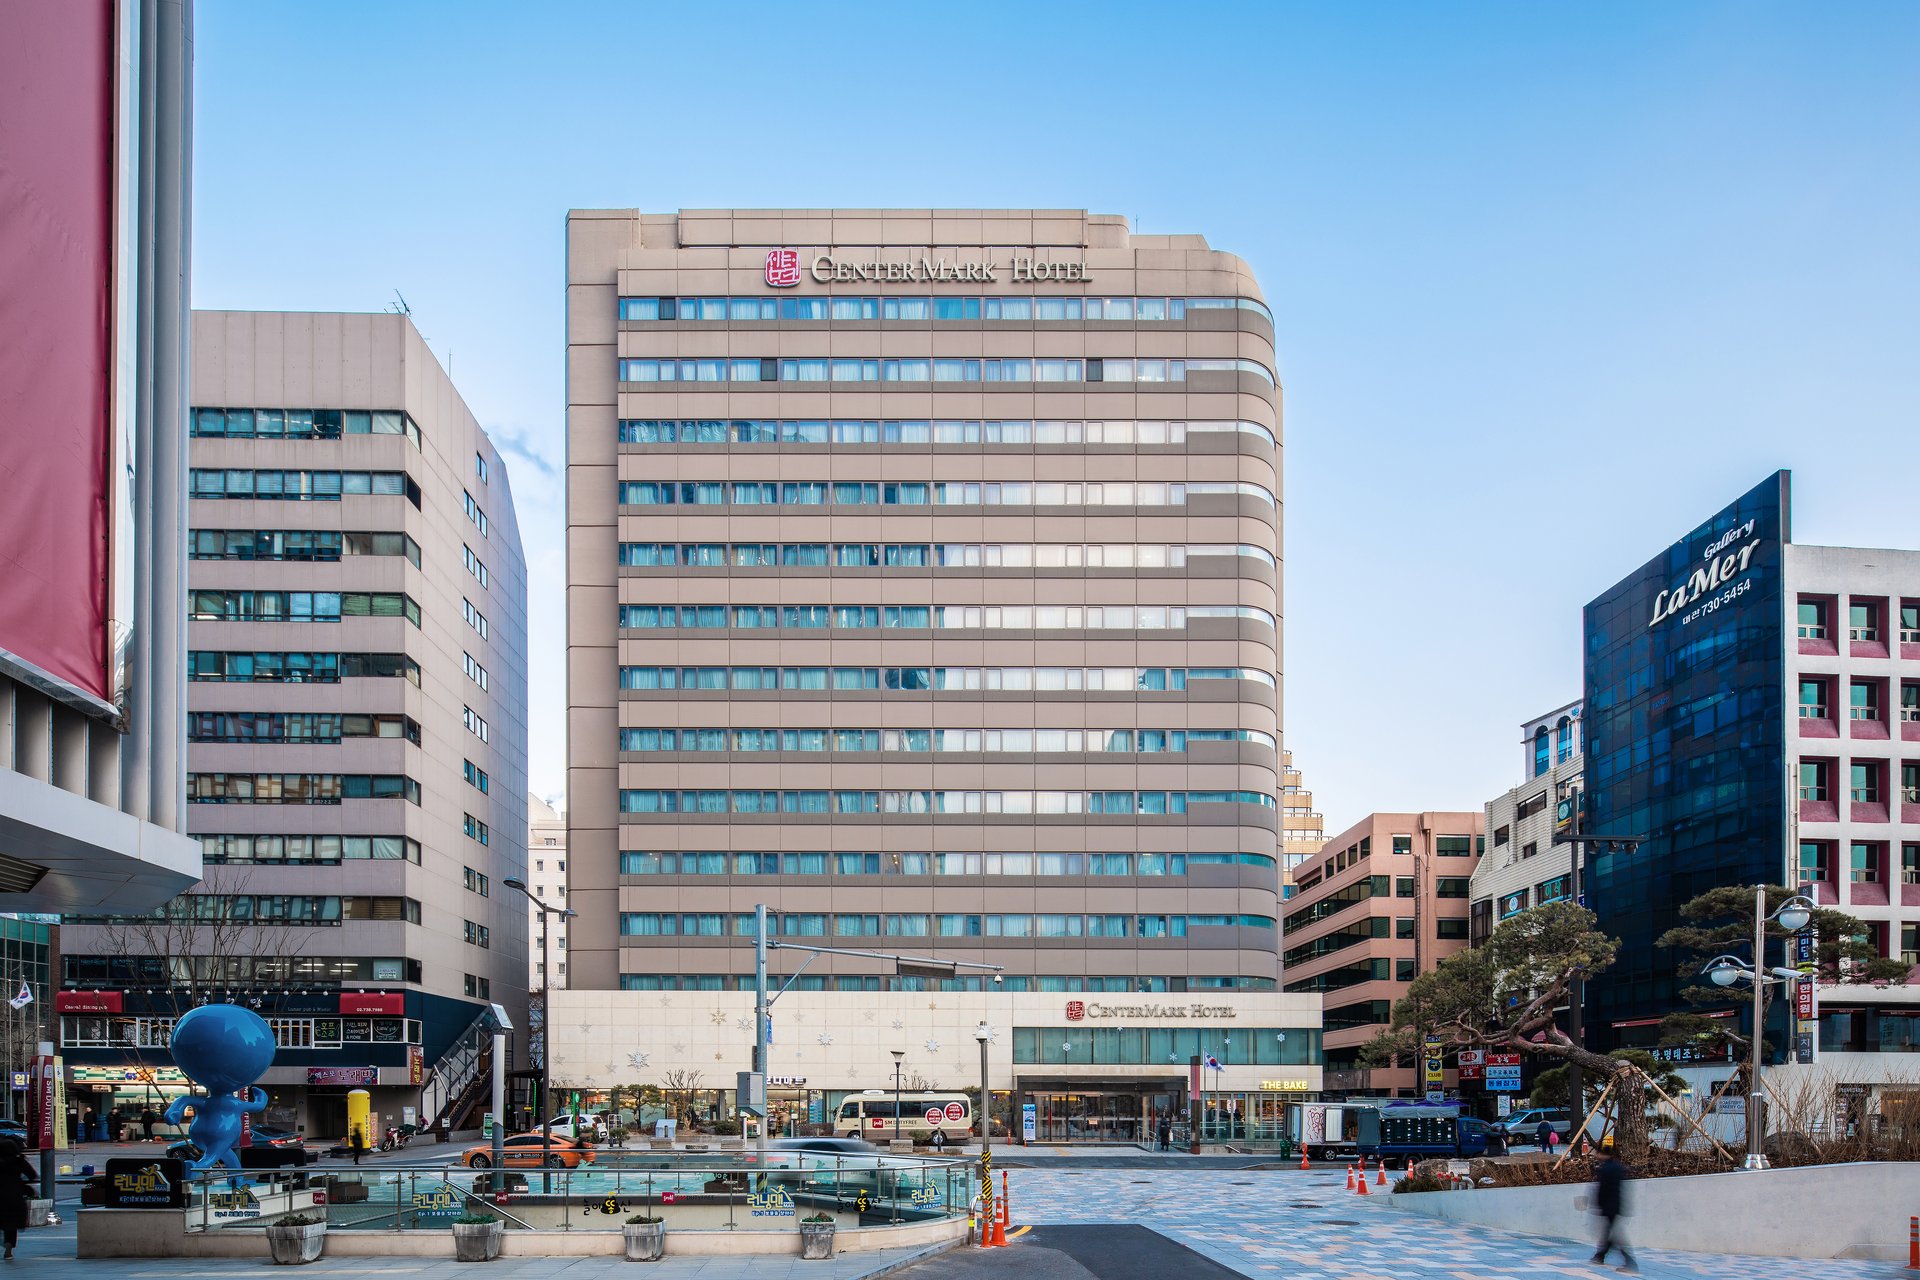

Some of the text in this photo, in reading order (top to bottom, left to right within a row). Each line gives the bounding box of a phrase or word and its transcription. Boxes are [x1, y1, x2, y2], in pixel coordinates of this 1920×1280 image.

[1012, 257, 1095, 284] HOTEL
[1703, 519, 1755, 561] Gallery
[1701, 578, 1751, 617] 730-5454
[1191, 1004, 1237, 1018] HOTEL
[1262, 1081, 1308, 1089] THE BAKE
[114, 1174, 155, 1193] 런닝맨
[209, 1193, 249, 1210] 런닝맨
[412, 1193, 450, 1210] 런닝맨
[747, 1193, 784, 1210] 런닝맨
